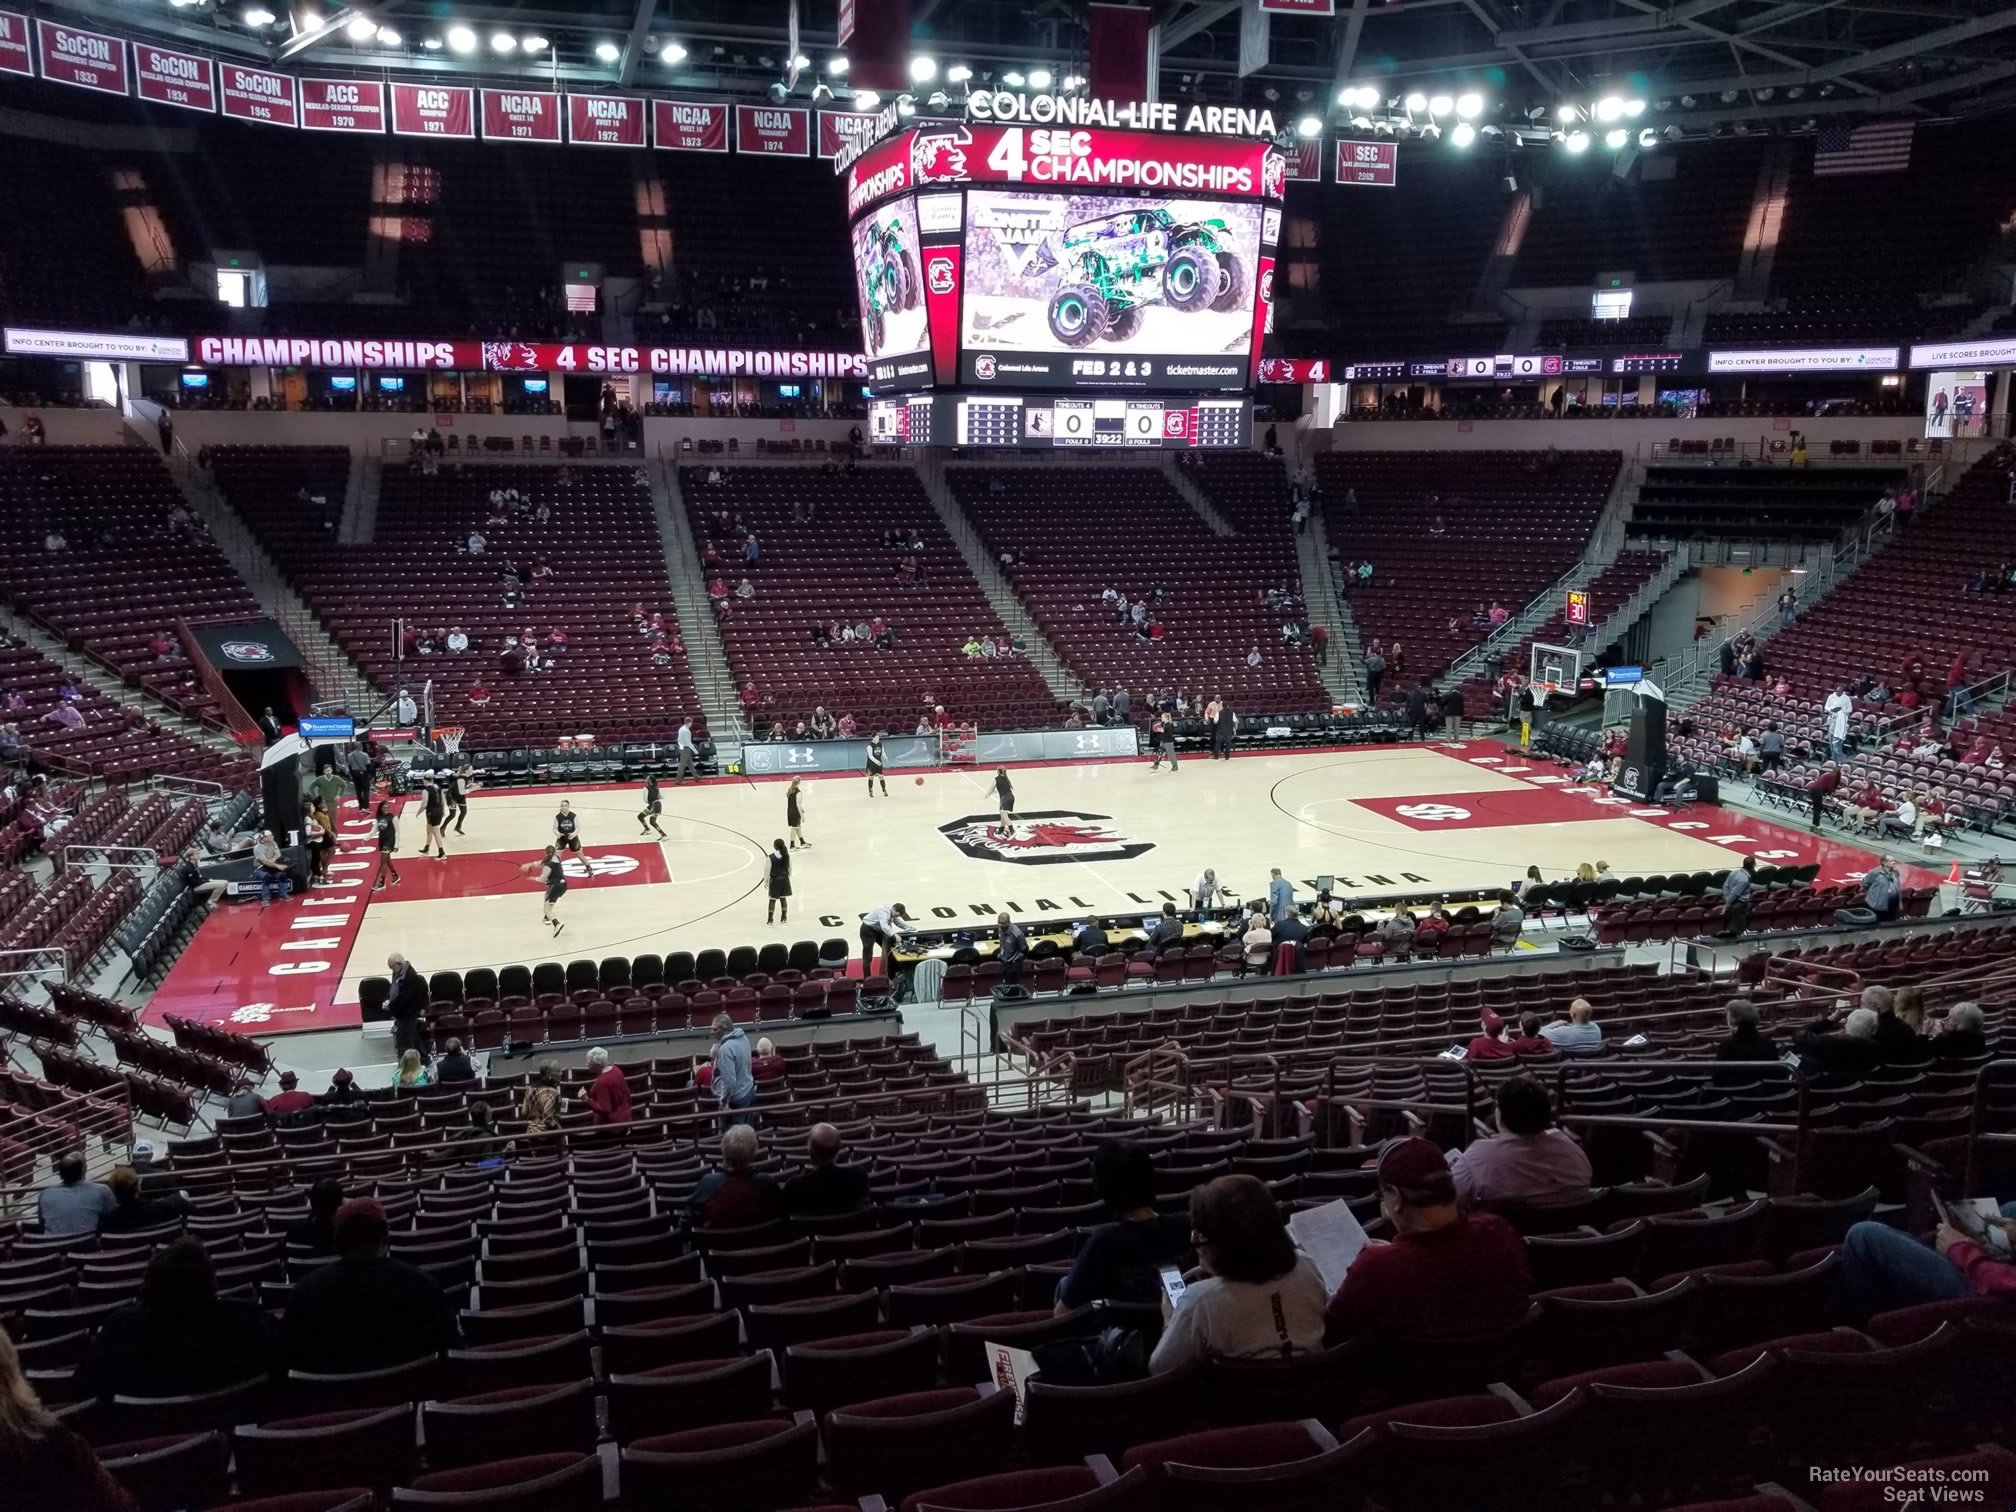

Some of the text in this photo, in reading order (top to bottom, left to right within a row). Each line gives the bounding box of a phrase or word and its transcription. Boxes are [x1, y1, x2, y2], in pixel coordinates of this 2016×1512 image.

[56, 30, 110, 61] SoCON
[151, 53, 199, 80] SoCON
[73, 69, 98, 84] 1933
[235, 71, 281, 97] SoCON
[166, 88, 188, 102] 1934
[326, 84, 359, 104] ACC
[416, 90, 449, 110] ACC
[250, 105, 271, 119] 1945
[501, 94, 542, 115] NCAA
[587, 100, 628, 120] NCAA
[968, 90, 1276, 136] COLONIAL LIFE ARENA
[332, 116, 355, 127] 1970
[672, 106, 712, 126] NCAA
[754, 111, 792, 130] NCAA
[423, 121, 445, 132] 1971
[511, 126, 532, 137] 1971
[598, 130, 618, 142] 1972
[681, 137, 702, 147] 1973
[1030, 130, 1092, 156] SEC
[763, 141, 784, 151] 1974
[987, 128, 1028, 181] 4
[1356, 146, 1378, 161] SEC
[1030, 155, 1252, 191] CHAMPIONSHIPS
[1358, 172, 1374, 181] 2009
[68, 342, 103, 350] BROUGHT
[201, 338, 454, 368] CHAMPIONSHIPS
[1980, 348, 2016, 356] BROUGHT
[556, 346, 868, 378] 4 SEC CHAMPIONSHIPS
[1072, 360, 1152, 376] FEB 2 & 3
[1167, 364, 1238, 376] ticketmaster.com
[1476, 362, 1486, 373] 0
[1522, 360, 1532, 372] 0
[1308, 362, 1324, 382] 4
[1067, 415, 1081, 433] 0
[1138, 416, 1152, 434] 0
[1096, 434, 1122, 444] 39:22
[1572, 604, 1584, 619] 30
[819, 896, 1095, 927] CLONIAL
